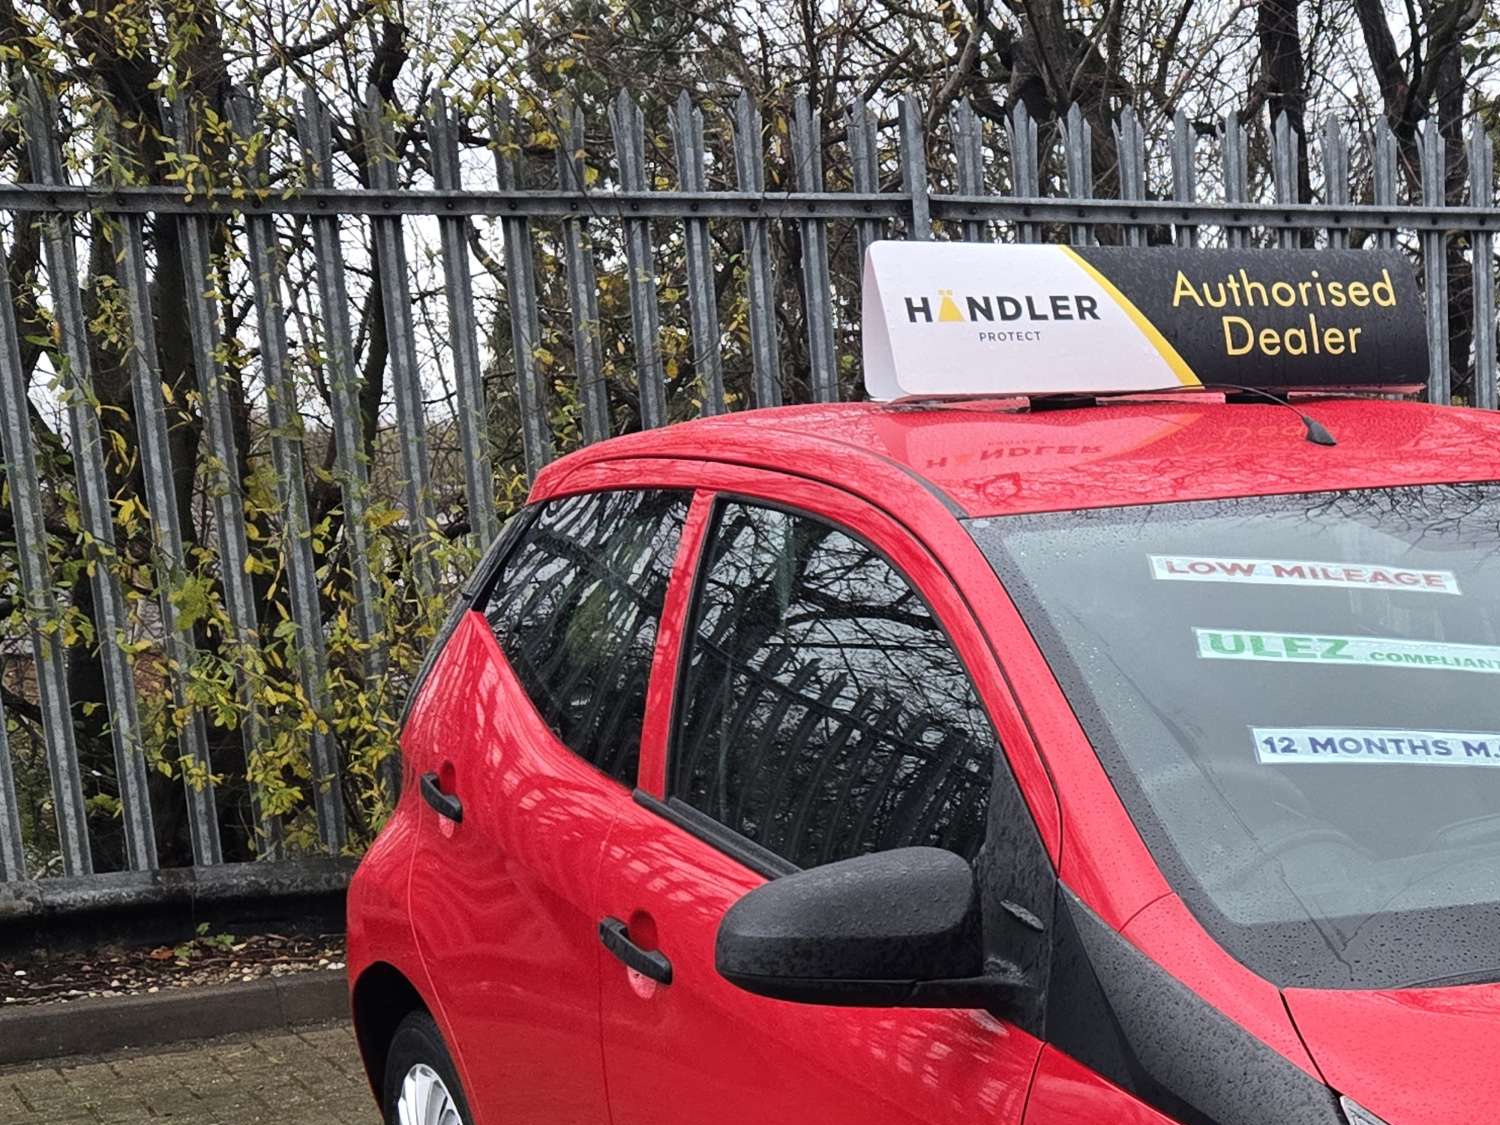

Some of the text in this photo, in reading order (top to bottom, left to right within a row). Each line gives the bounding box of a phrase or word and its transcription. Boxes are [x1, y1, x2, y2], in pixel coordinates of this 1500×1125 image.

[1172, 267, 1396, 309] Authorised
[978, 330, 1041, 342] PROTECT
[1222, 314, 1362, 357] Dealer
[1166, 560, 1447, 588] LOW MILEAGE
[1208, 632, 1354, 661] ULEZ
[1262, 736, 1298, 755] 12
[1309, 736, 1448, 757] MONTHS
